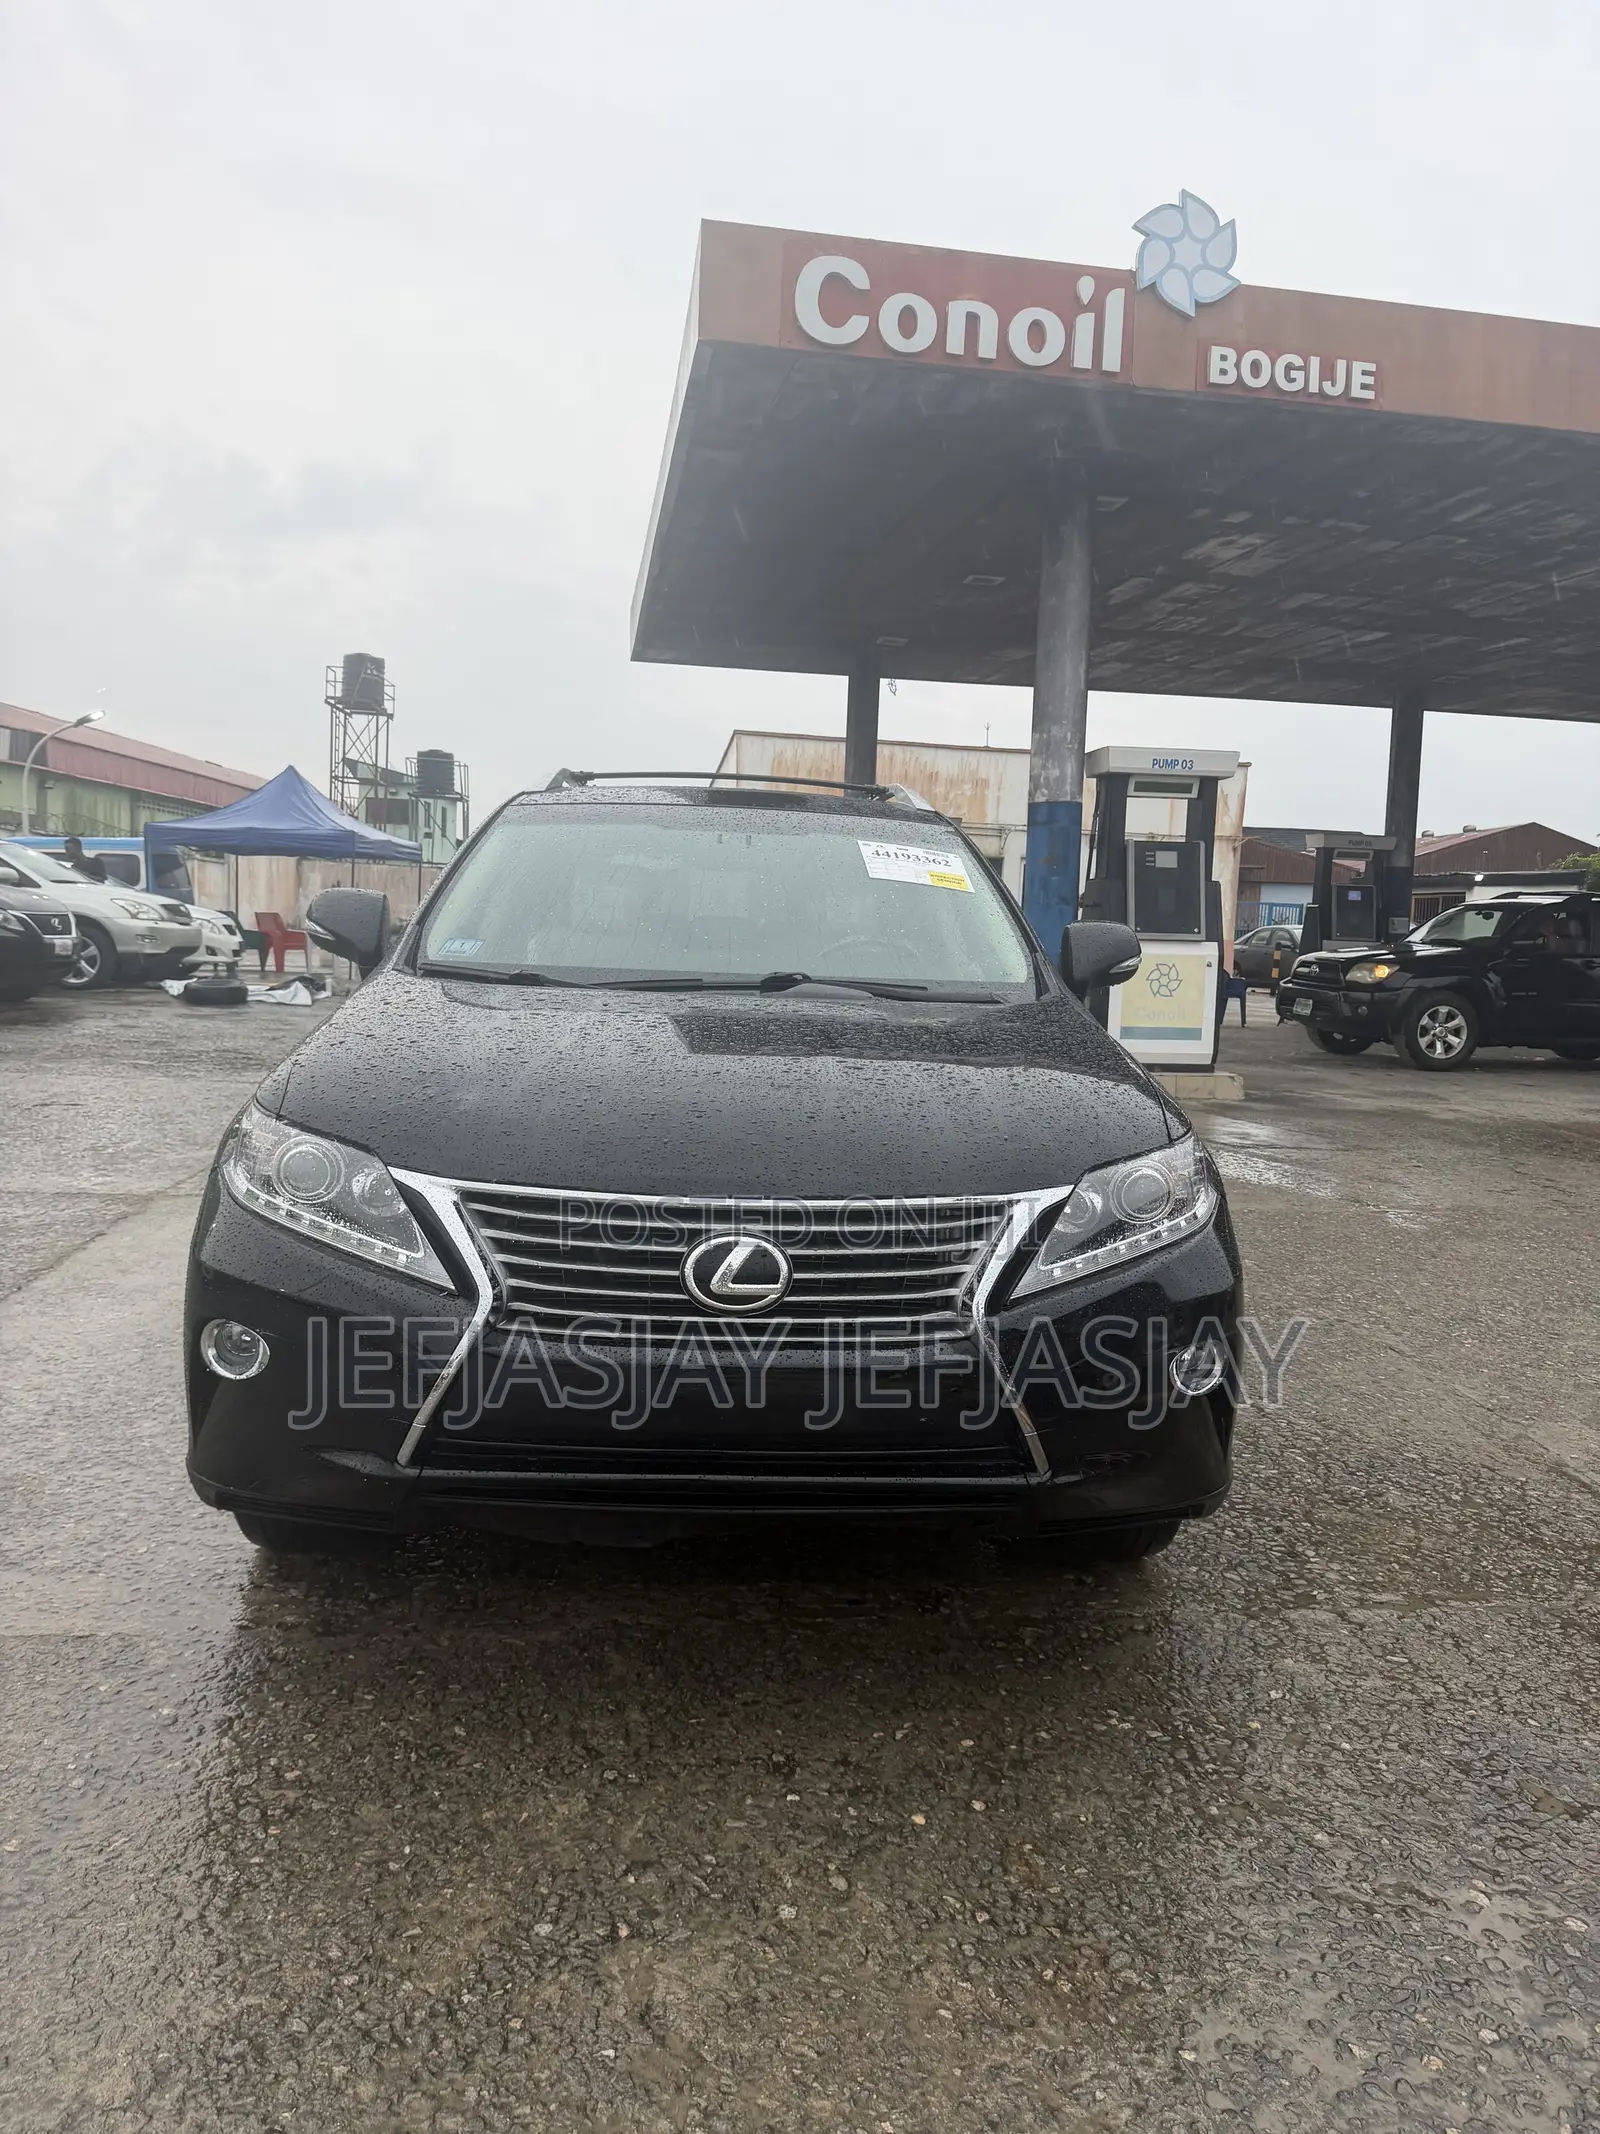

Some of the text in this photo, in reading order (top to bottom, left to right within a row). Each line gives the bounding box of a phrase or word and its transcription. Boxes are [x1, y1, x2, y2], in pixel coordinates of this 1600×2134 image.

[795, 255, 1126, 373] Conoil
[1207, 345, 1377, 400] BOGIJE
[1152, 758, 1194, 770] PUMP 03
[871, 849, 951, 867] 44193362
